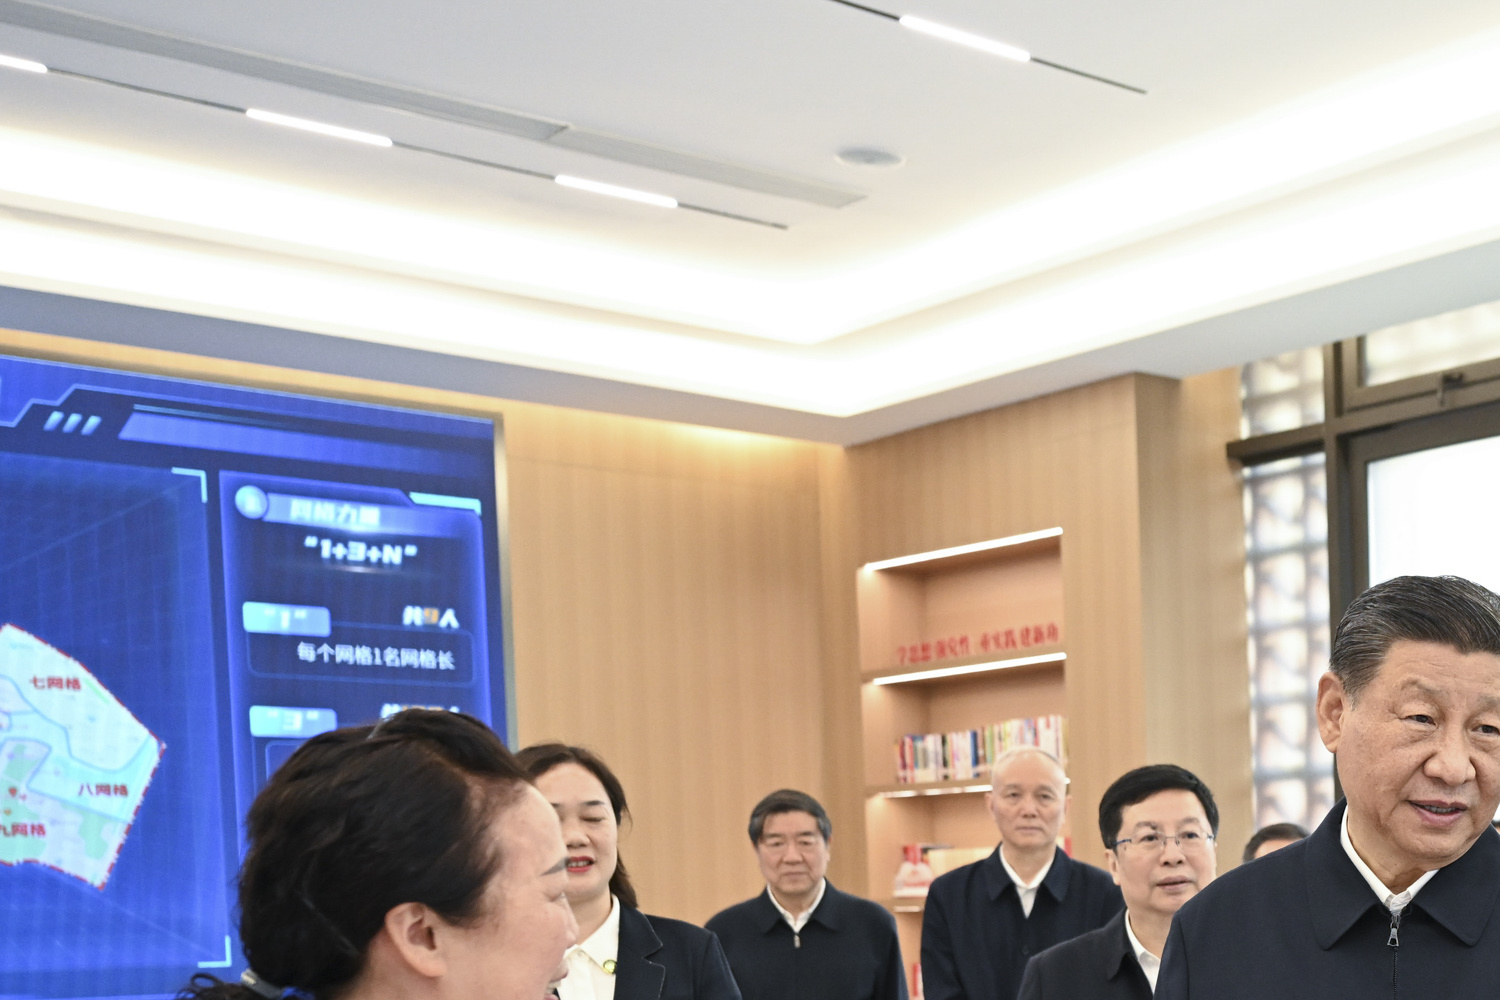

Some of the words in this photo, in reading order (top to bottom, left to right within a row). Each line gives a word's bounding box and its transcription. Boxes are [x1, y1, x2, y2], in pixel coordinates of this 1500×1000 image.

[297, 641, 456, 671] 每个网格1名网格长
[30, 675, 82, 691] 七网格
[78, 783, 129, 798] 八网格
